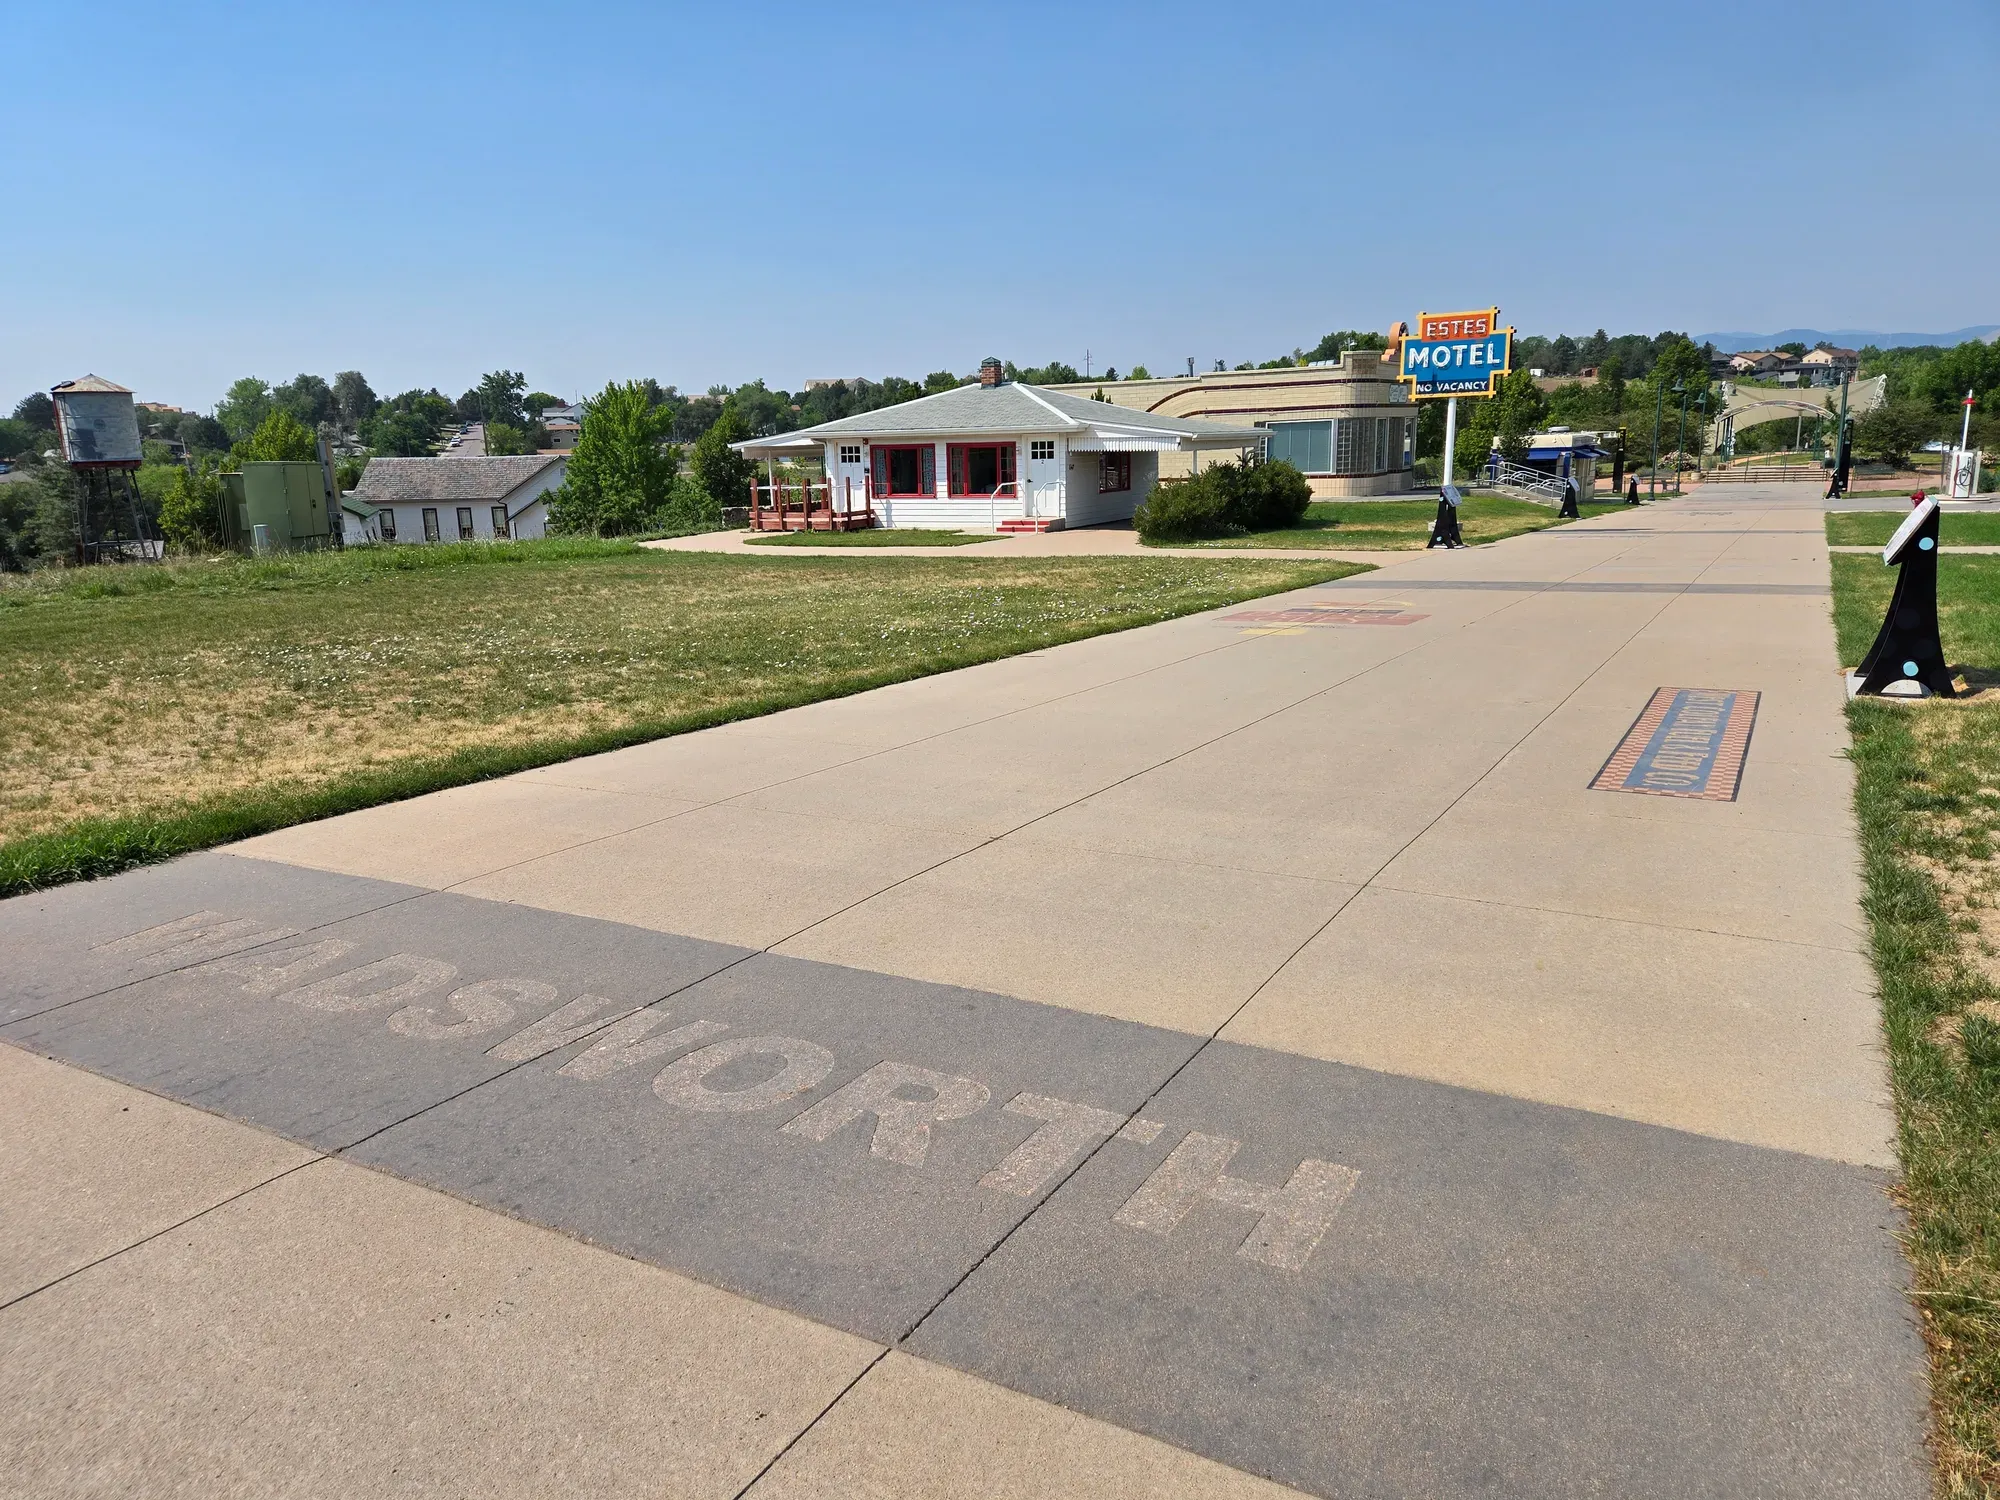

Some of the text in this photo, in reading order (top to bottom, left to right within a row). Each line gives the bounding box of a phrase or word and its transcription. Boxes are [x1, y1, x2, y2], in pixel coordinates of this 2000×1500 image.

[1426, 318, 1488, 337] ESTES
[1408, 342, 1501, 369] MOTEL
[1416, 384, 1433, 393] NO
[1436, 380, 1488, 392] VACANCY
[88, 910, 1362, 1272] WADSWORTH
